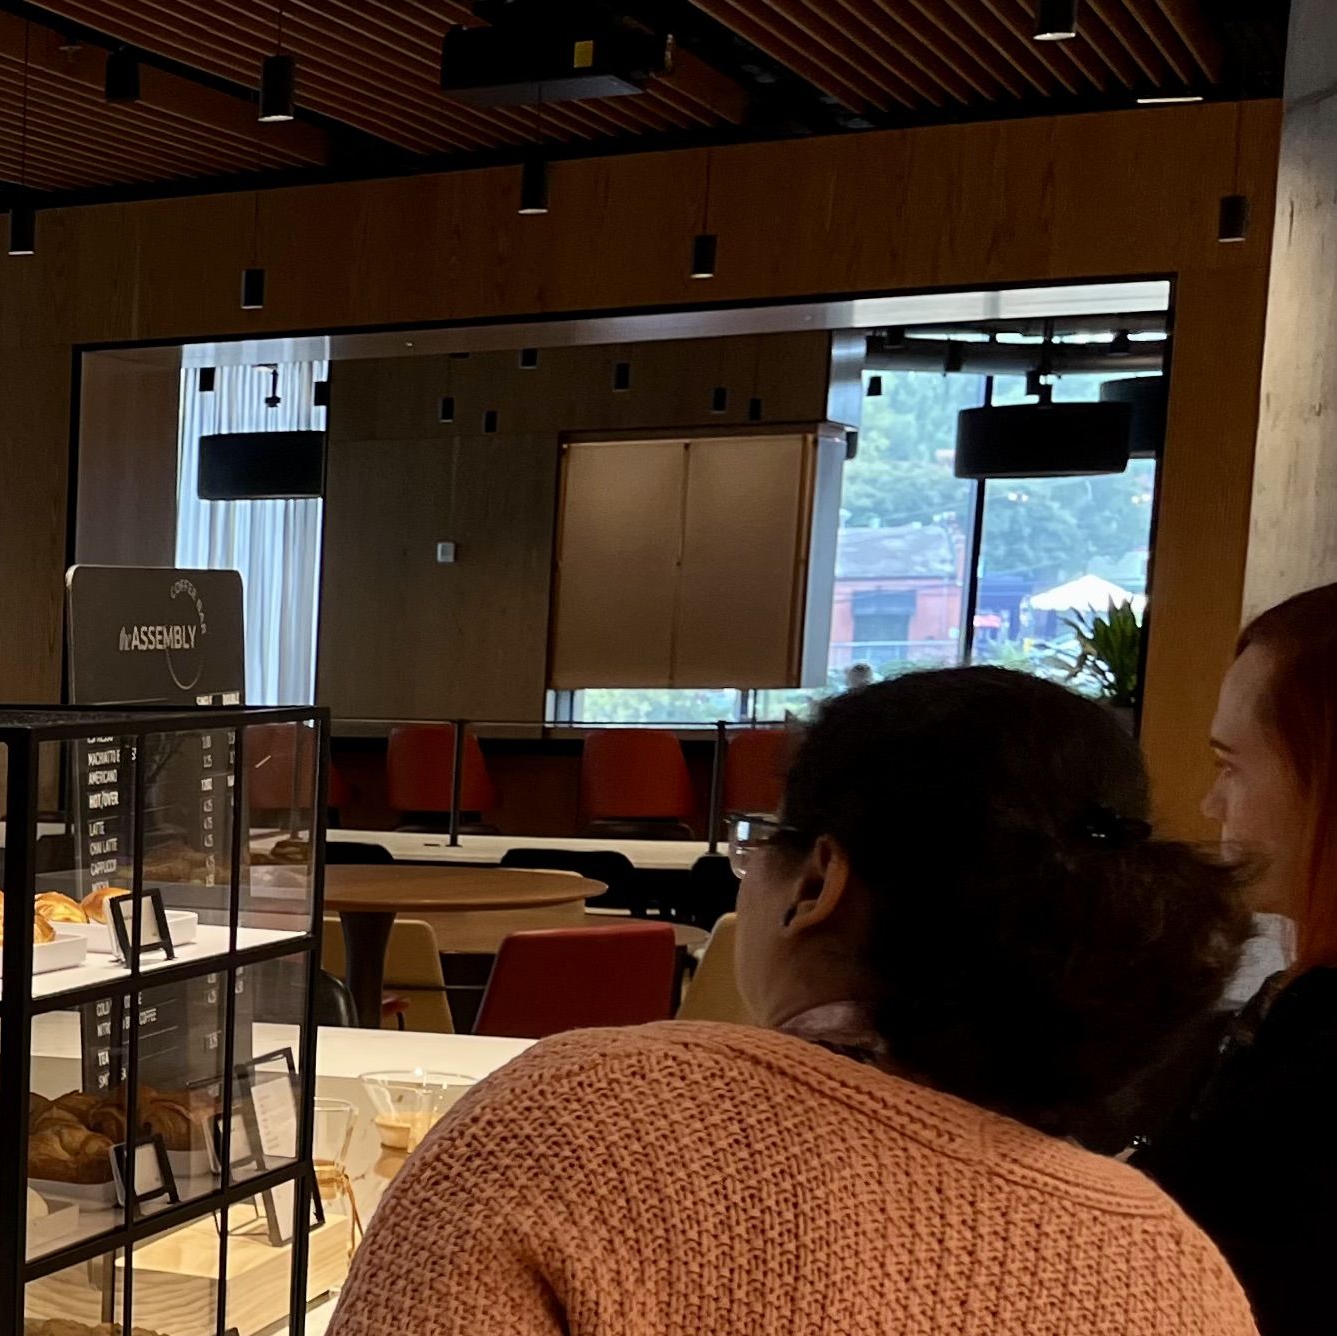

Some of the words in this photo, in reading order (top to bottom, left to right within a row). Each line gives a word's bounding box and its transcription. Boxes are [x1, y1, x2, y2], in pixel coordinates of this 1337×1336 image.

[131, 625, 197, 650] ASSEMBLY
[89, 821, 105, 837] LATTE
[98, 1051, 110, 1066] TEA
